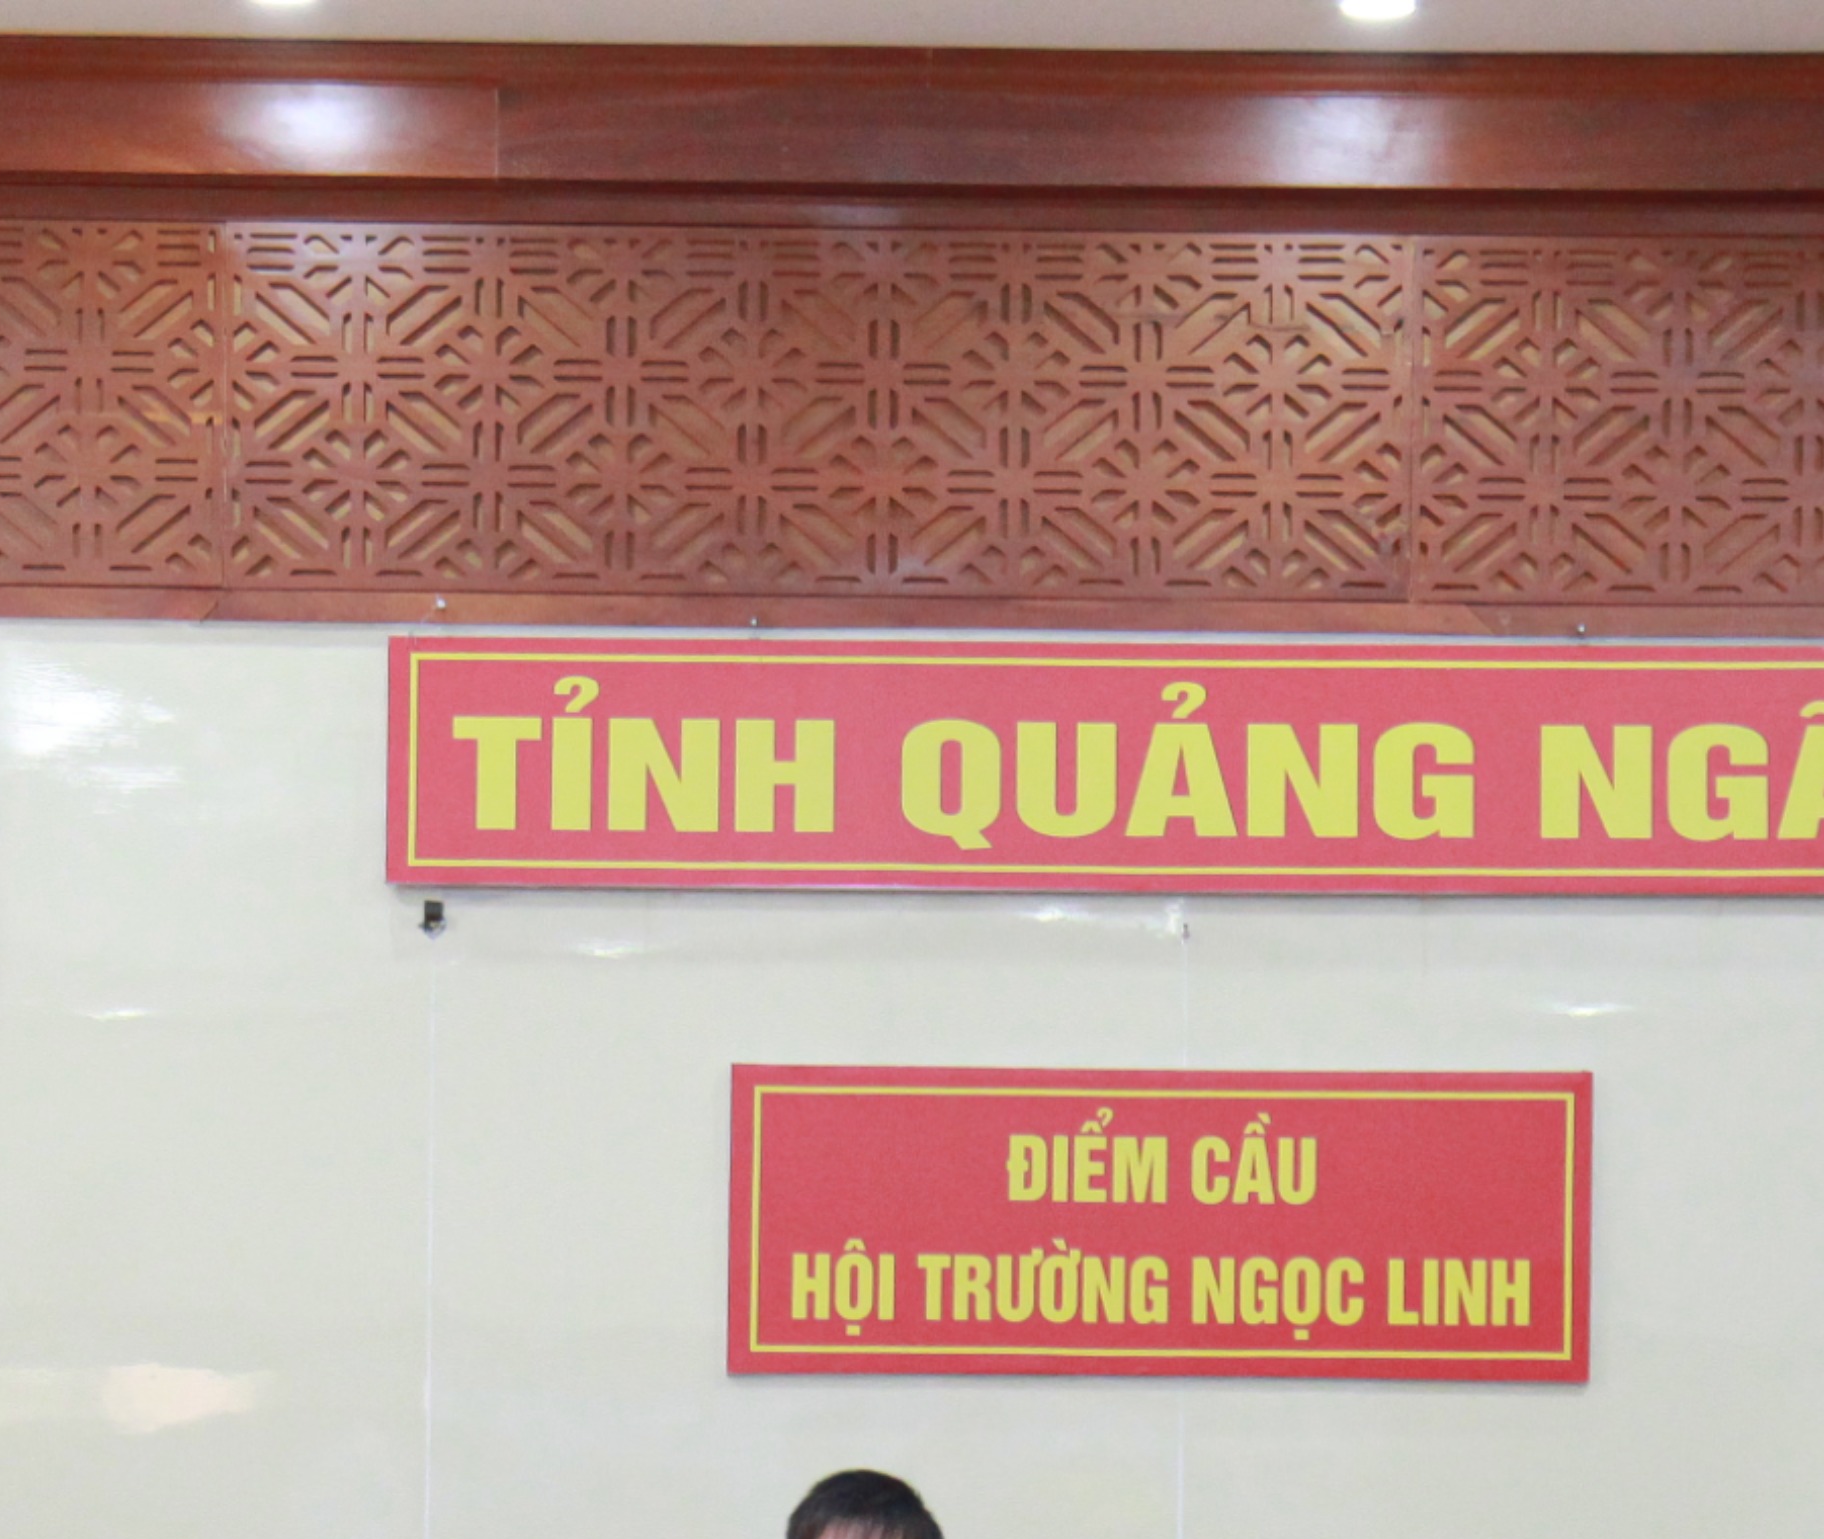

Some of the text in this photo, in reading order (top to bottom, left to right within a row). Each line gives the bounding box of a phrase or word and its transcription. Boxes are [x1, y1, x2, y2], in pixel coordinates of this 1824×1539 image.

[452, 676, 835, 833] TỈNH
[901, 681, 1474, 850] QUẢNG
[1006, 1107, 1317, 1205] ĐIỂM CẦU
[791, 1238, 1530, 1340] HỘI TRƯỜNG NGỌC LINH
